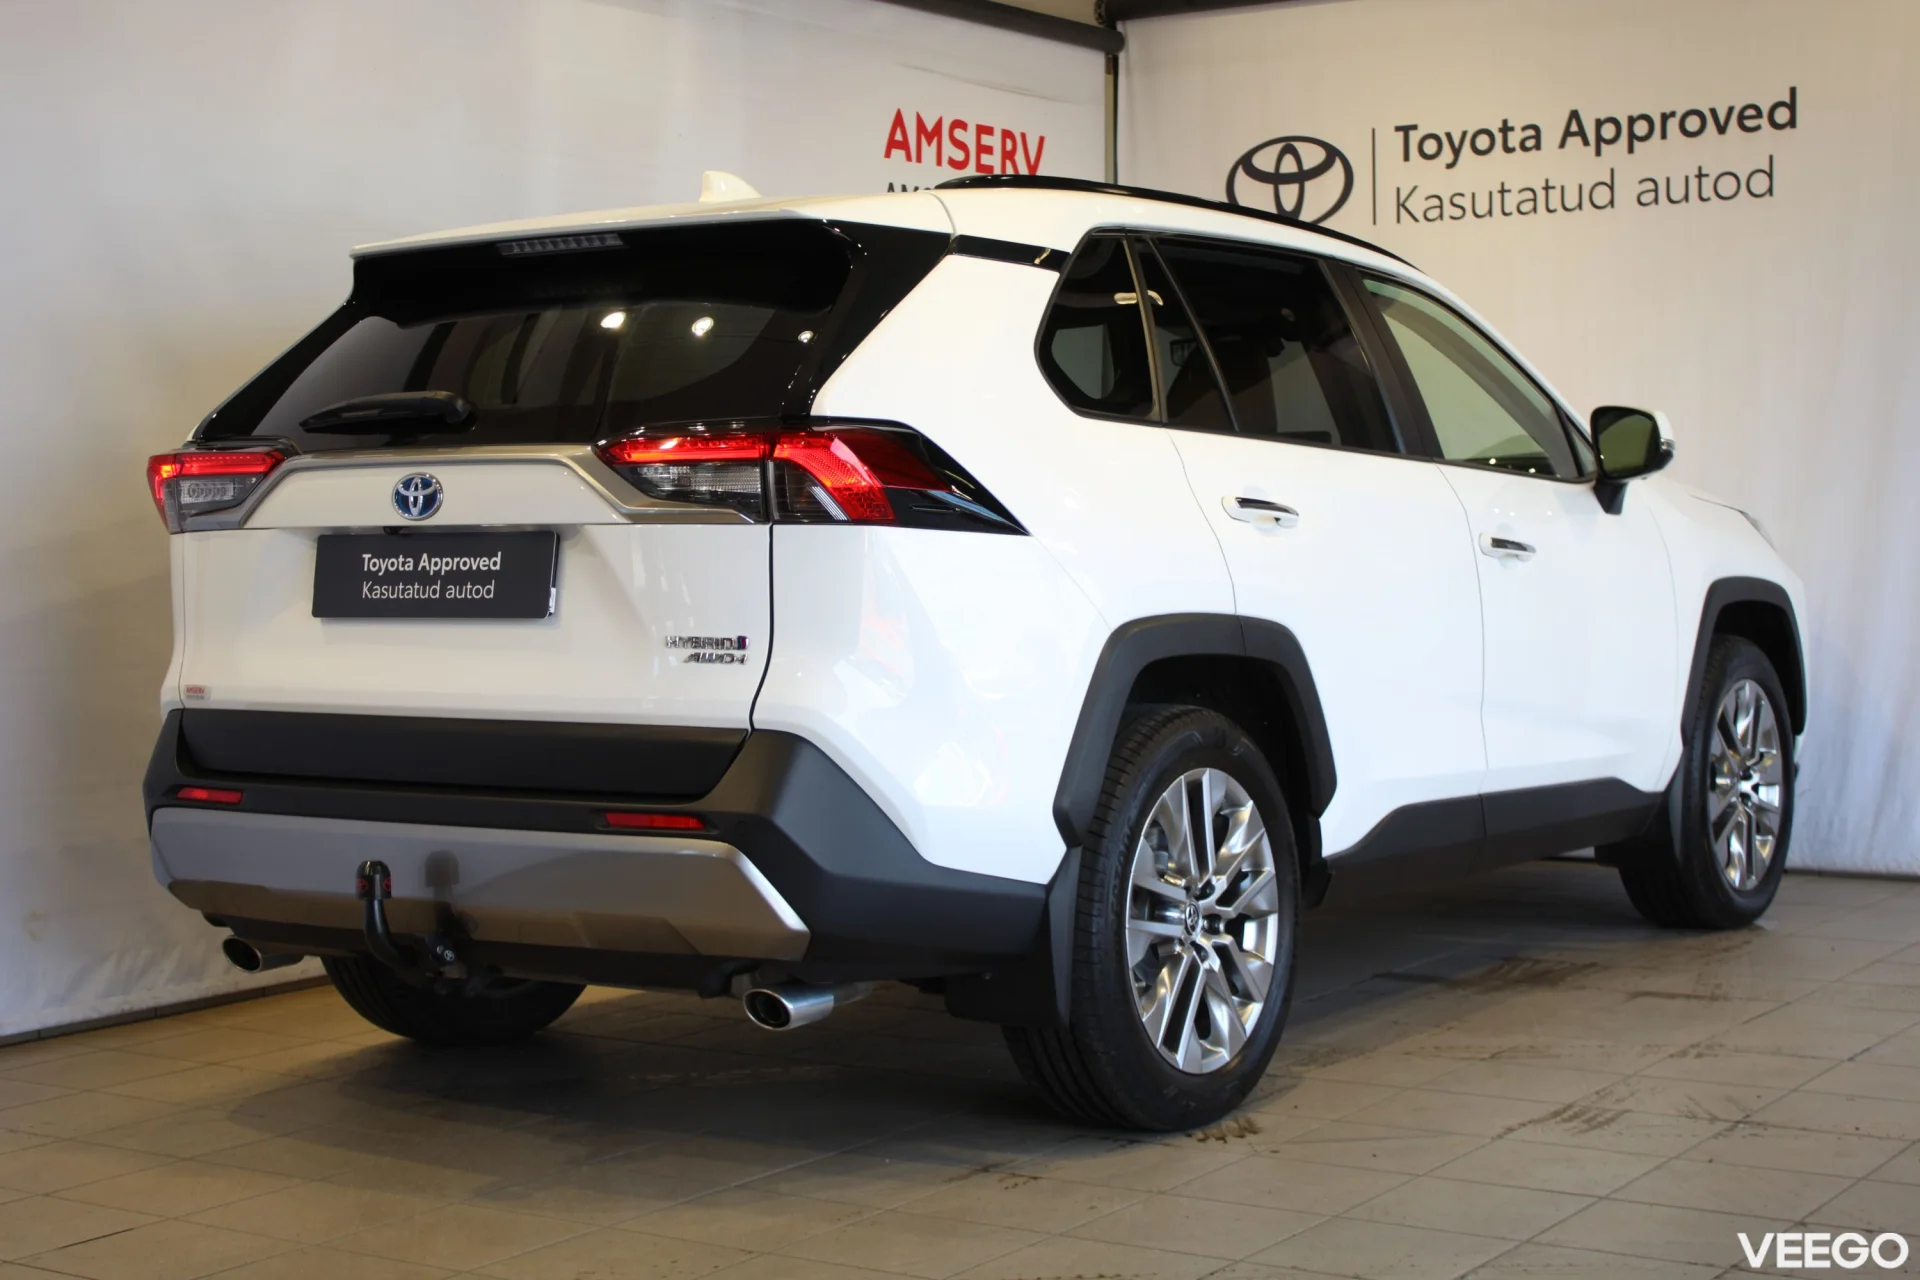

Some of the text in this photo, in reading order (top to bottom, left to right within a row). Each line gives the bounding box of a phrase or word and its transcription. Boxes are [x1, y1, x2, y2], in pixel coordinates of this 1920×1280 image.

[883, 107, 1046, 176] AMSERV
[1395, 86, 1798, 170] Toyota Approved
[1396, 155, 1775, 225] Kasutatud autod
[362, 551, 502, 576] Toyota Approved
[362, 579, 495, 599] Kasutatud autod
[665, 636, 735, 650] HYBRID
